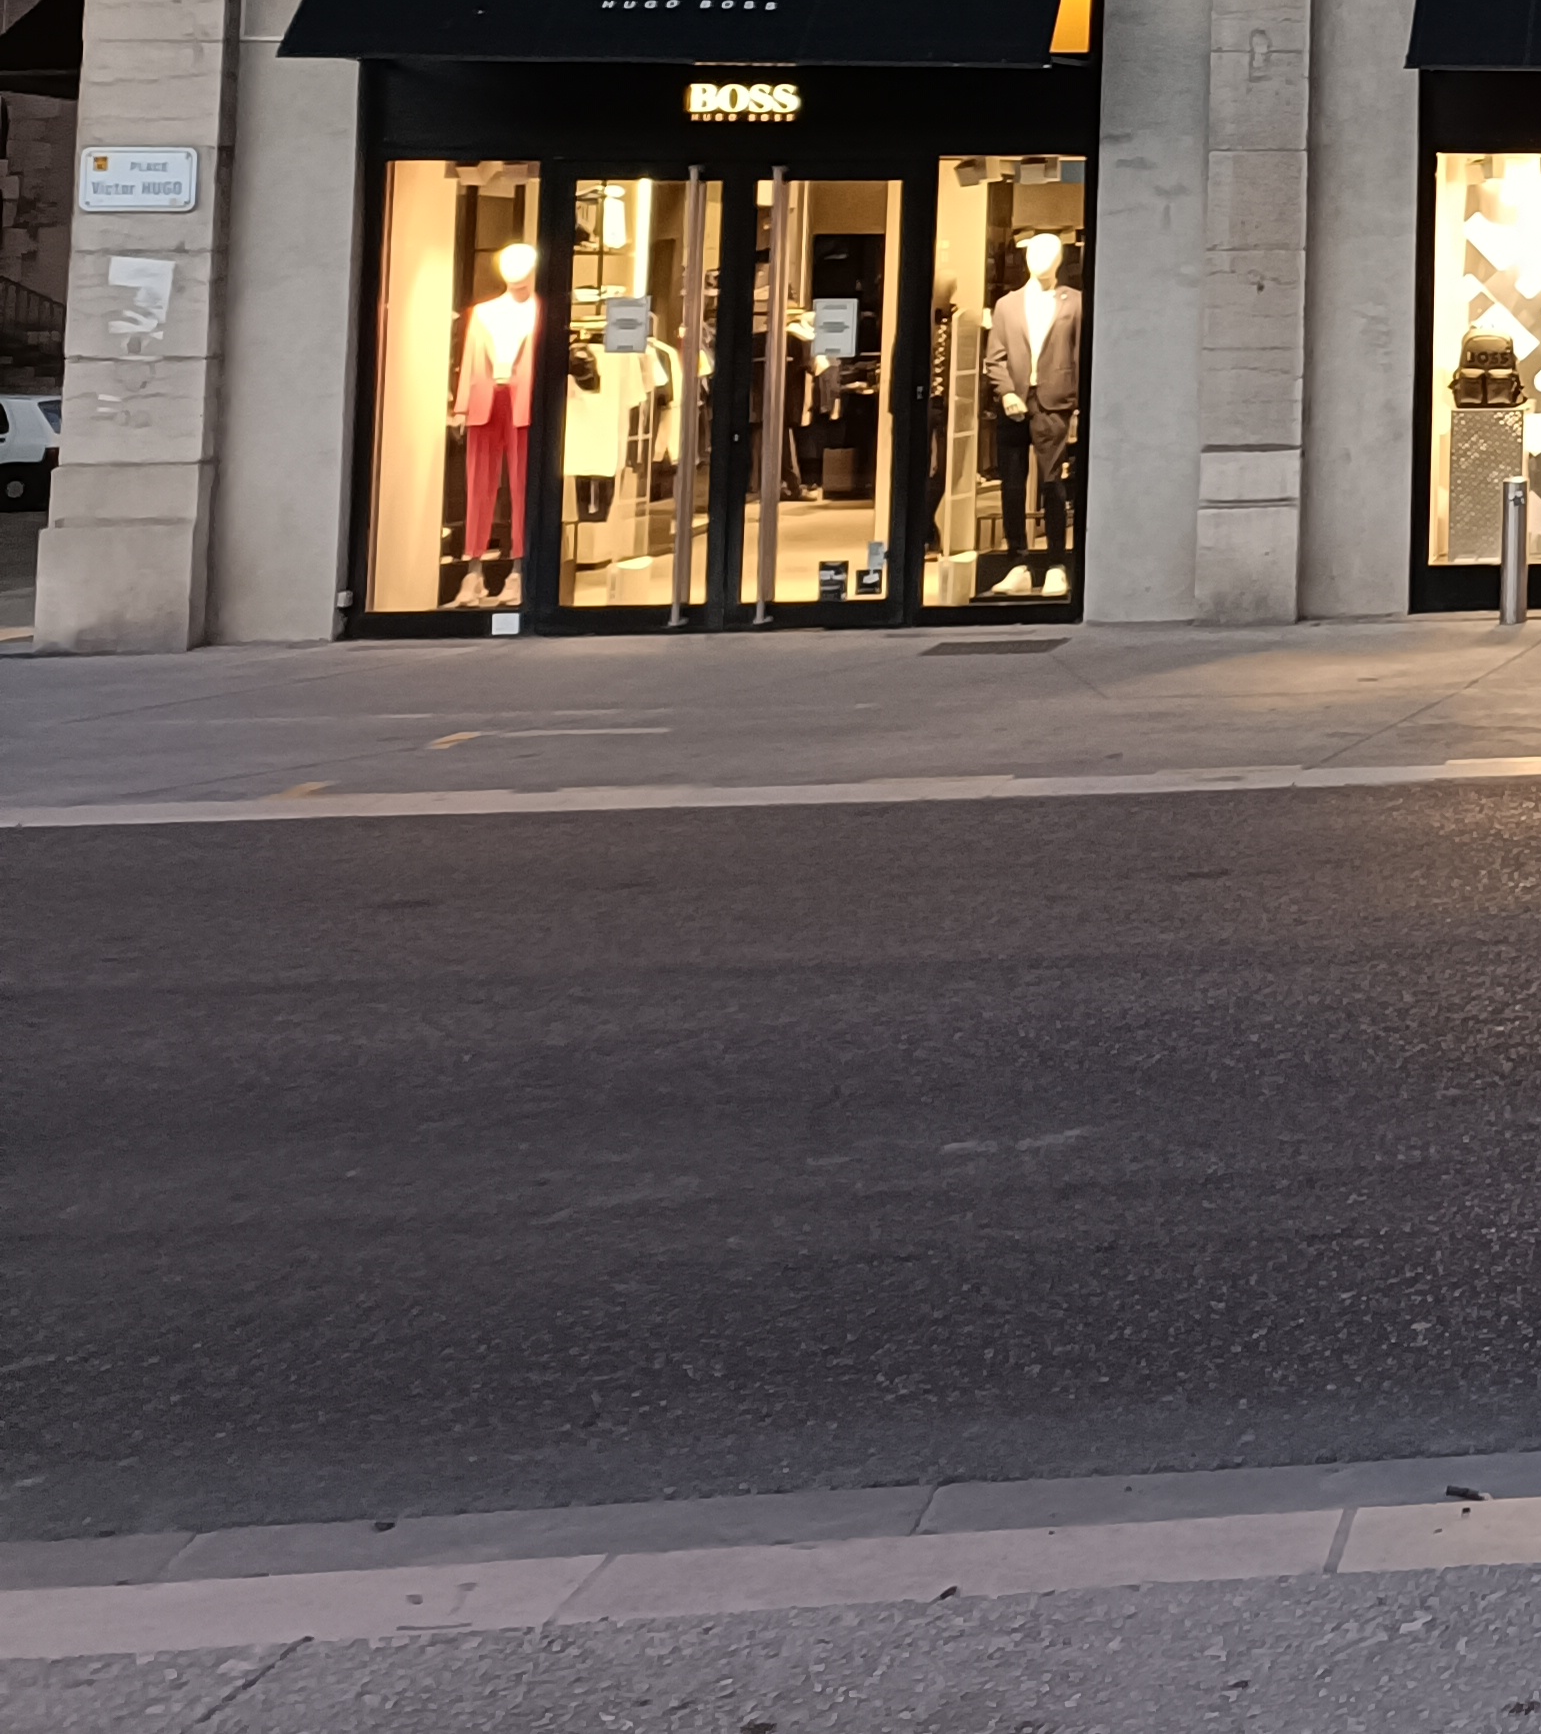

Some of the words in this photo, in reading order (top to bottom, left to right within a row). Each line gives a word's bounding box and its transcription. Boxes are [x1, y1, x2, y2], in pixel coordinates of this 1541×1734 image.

[601, 0, 681, 10] HUGO
[700, 0, 779, 11] BOSS
[686, 83, 801, 114] BOSS
[129, 161, 169, 172] PLACE
[91, 181, 136, 196] Victor
[141, 180, 183, 196] HUGO
